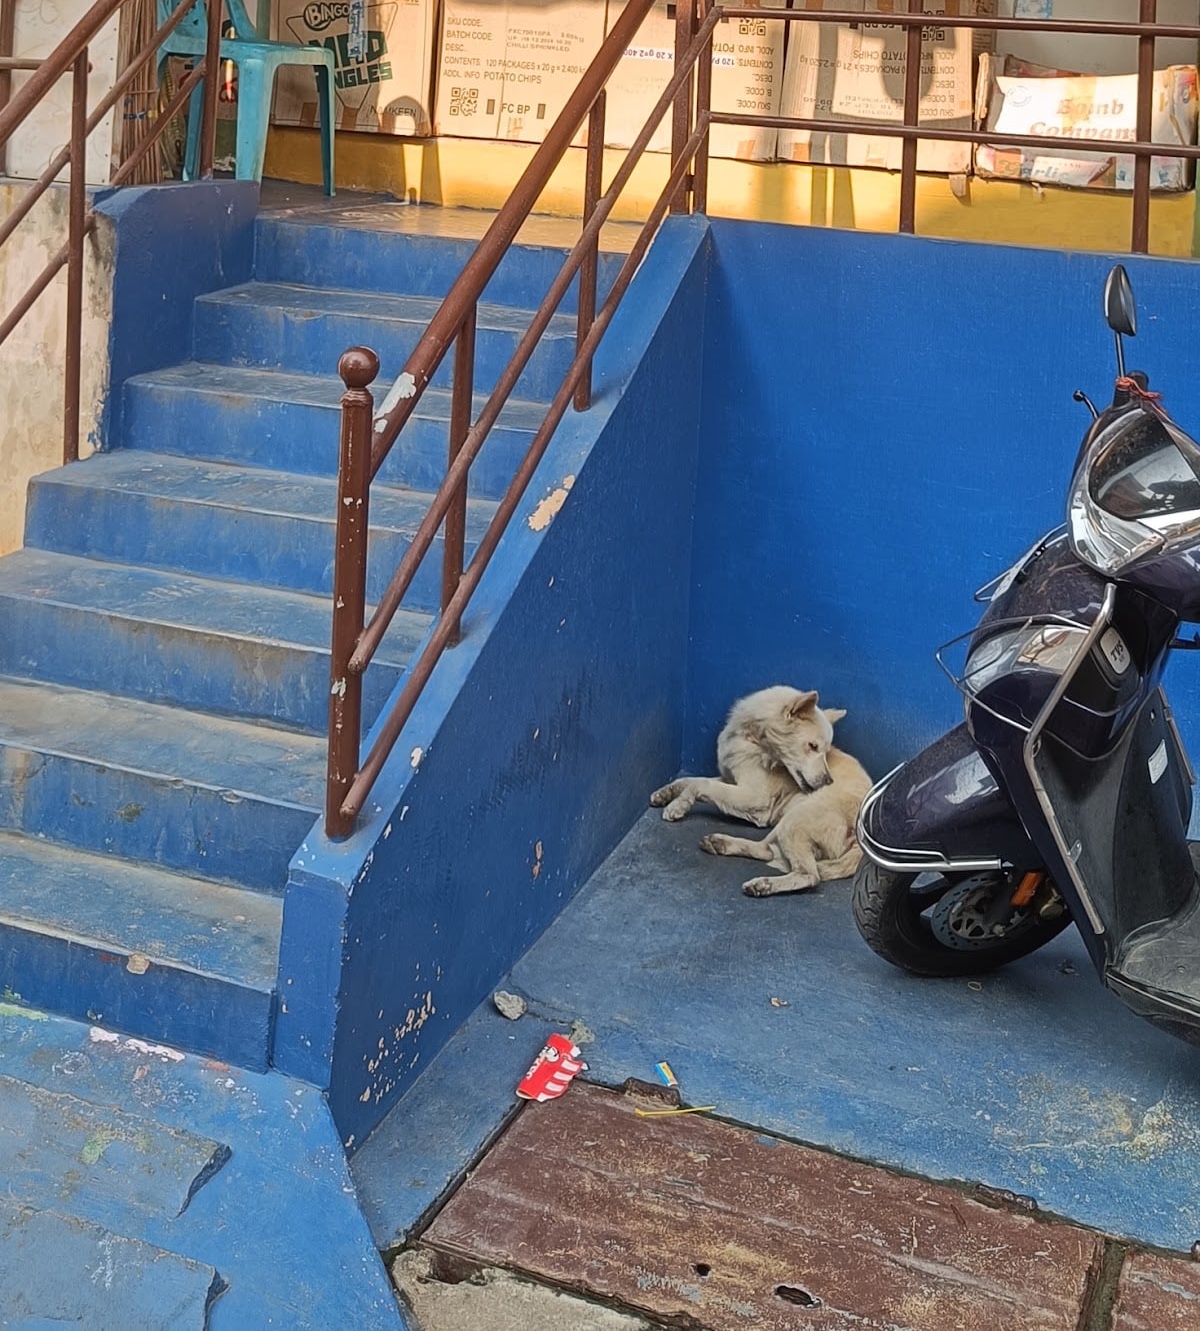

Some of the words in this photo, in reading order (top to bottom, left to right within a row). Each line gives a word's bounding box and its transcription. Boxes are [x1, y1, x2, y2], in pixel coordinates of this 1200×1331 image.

[446, 30, 471, 39] BATCH
[853, 50, 880, 60] CHIPS
[486, 59, 497, 68] 120
[498, 59, 535, 71] PACKAGES
[484, 71, 516, 82] POTATO
[517, 73, 542, 84] CHIPS
[1110, 640, 1124, 661] TVS
